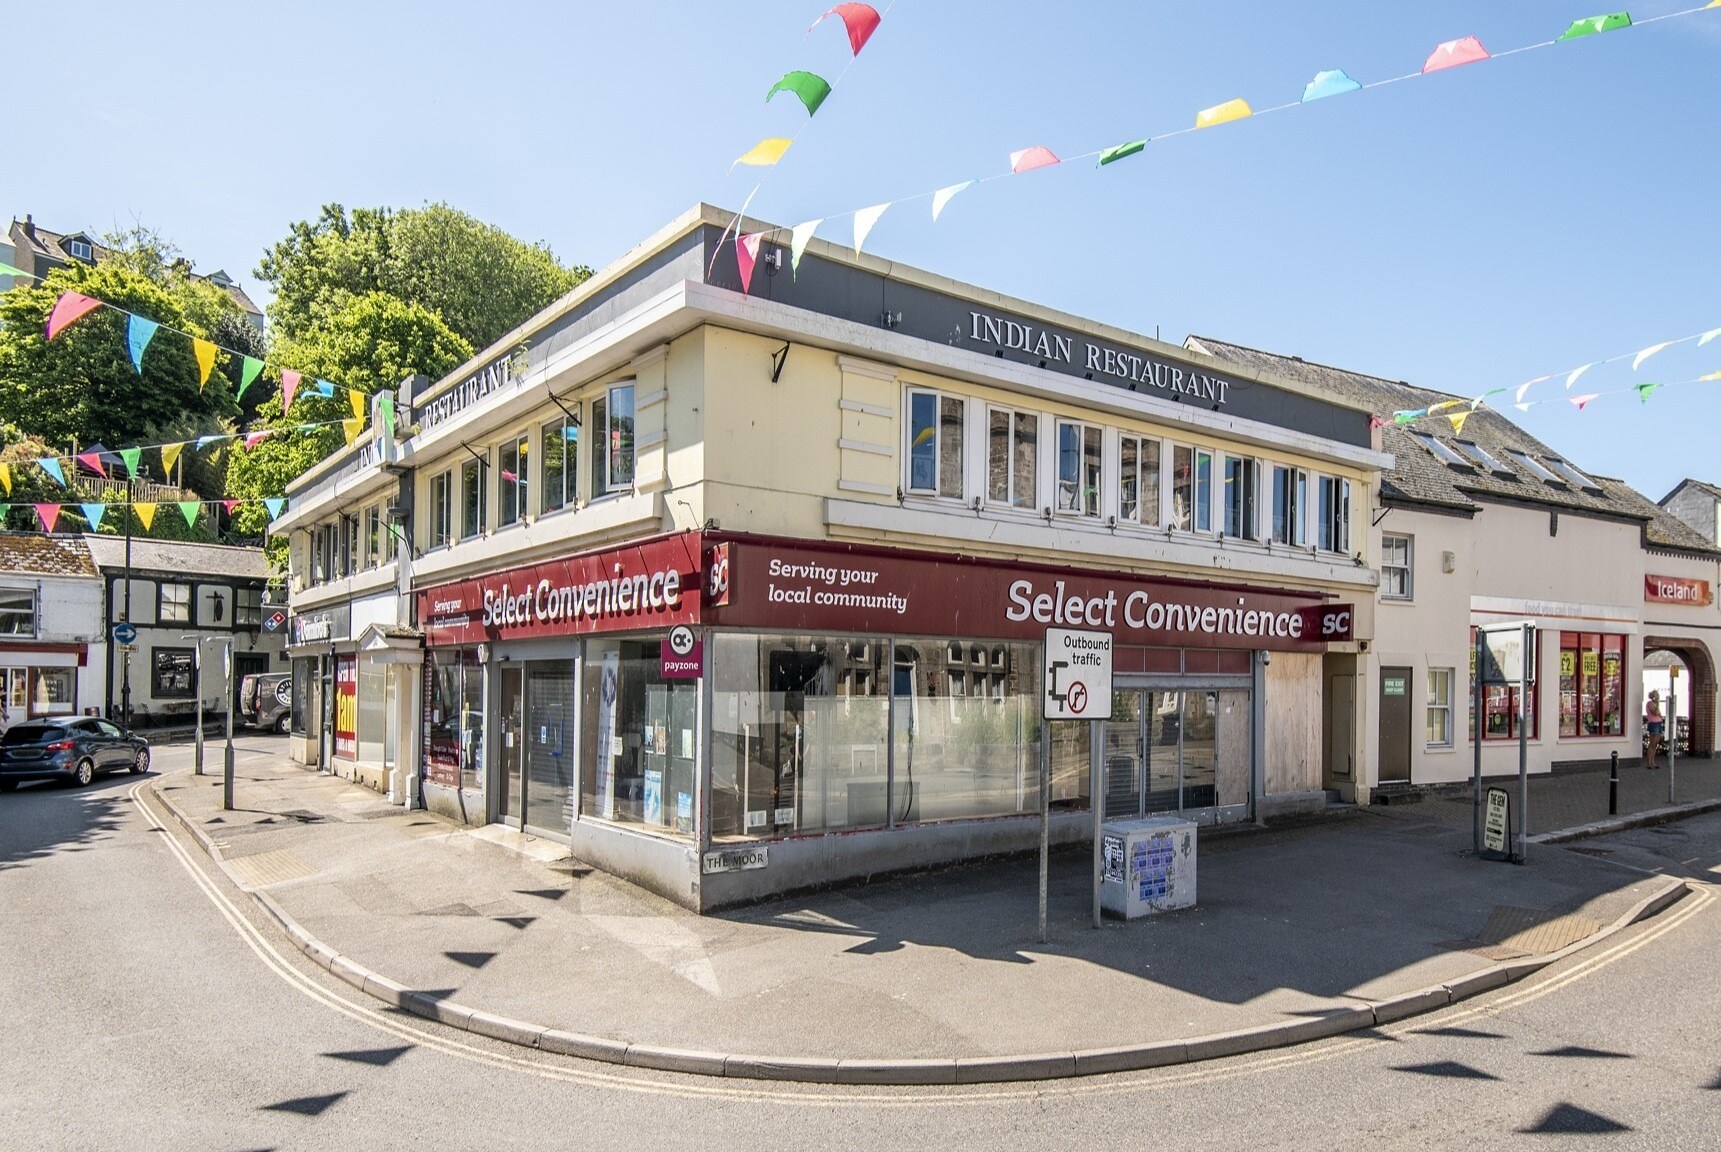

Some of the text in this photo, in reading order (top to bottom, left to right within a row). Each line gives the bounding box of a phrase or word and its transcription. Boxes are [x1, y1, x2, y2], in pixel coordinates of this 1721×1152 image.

[969, 311, 1229, 404] INDIAN RESTAURANT
[425, 354, 512, 430] RESTAURANT
[769, 559, 878, 586] Serving your
[482, 562, 680, 627] Select Convenience
[768, 584, 907, 614] local community
[1657, 580, 1698, 601] Iceland
[434, 598, 450, 614] Serving
[1005, 579, 1303, 638] Select Convenience
[1064, 635, 1110, 651] Outbound
[664, 661, 699, 672] payzone
[1072, 652, 1102, 666] traffic
[1561, 657, 1571, 671] £2
[1584, 661, 1596, 672] FREE
[336, 687, 356, 733] 1am
[706, 853, 764, 869] THE MOOR
